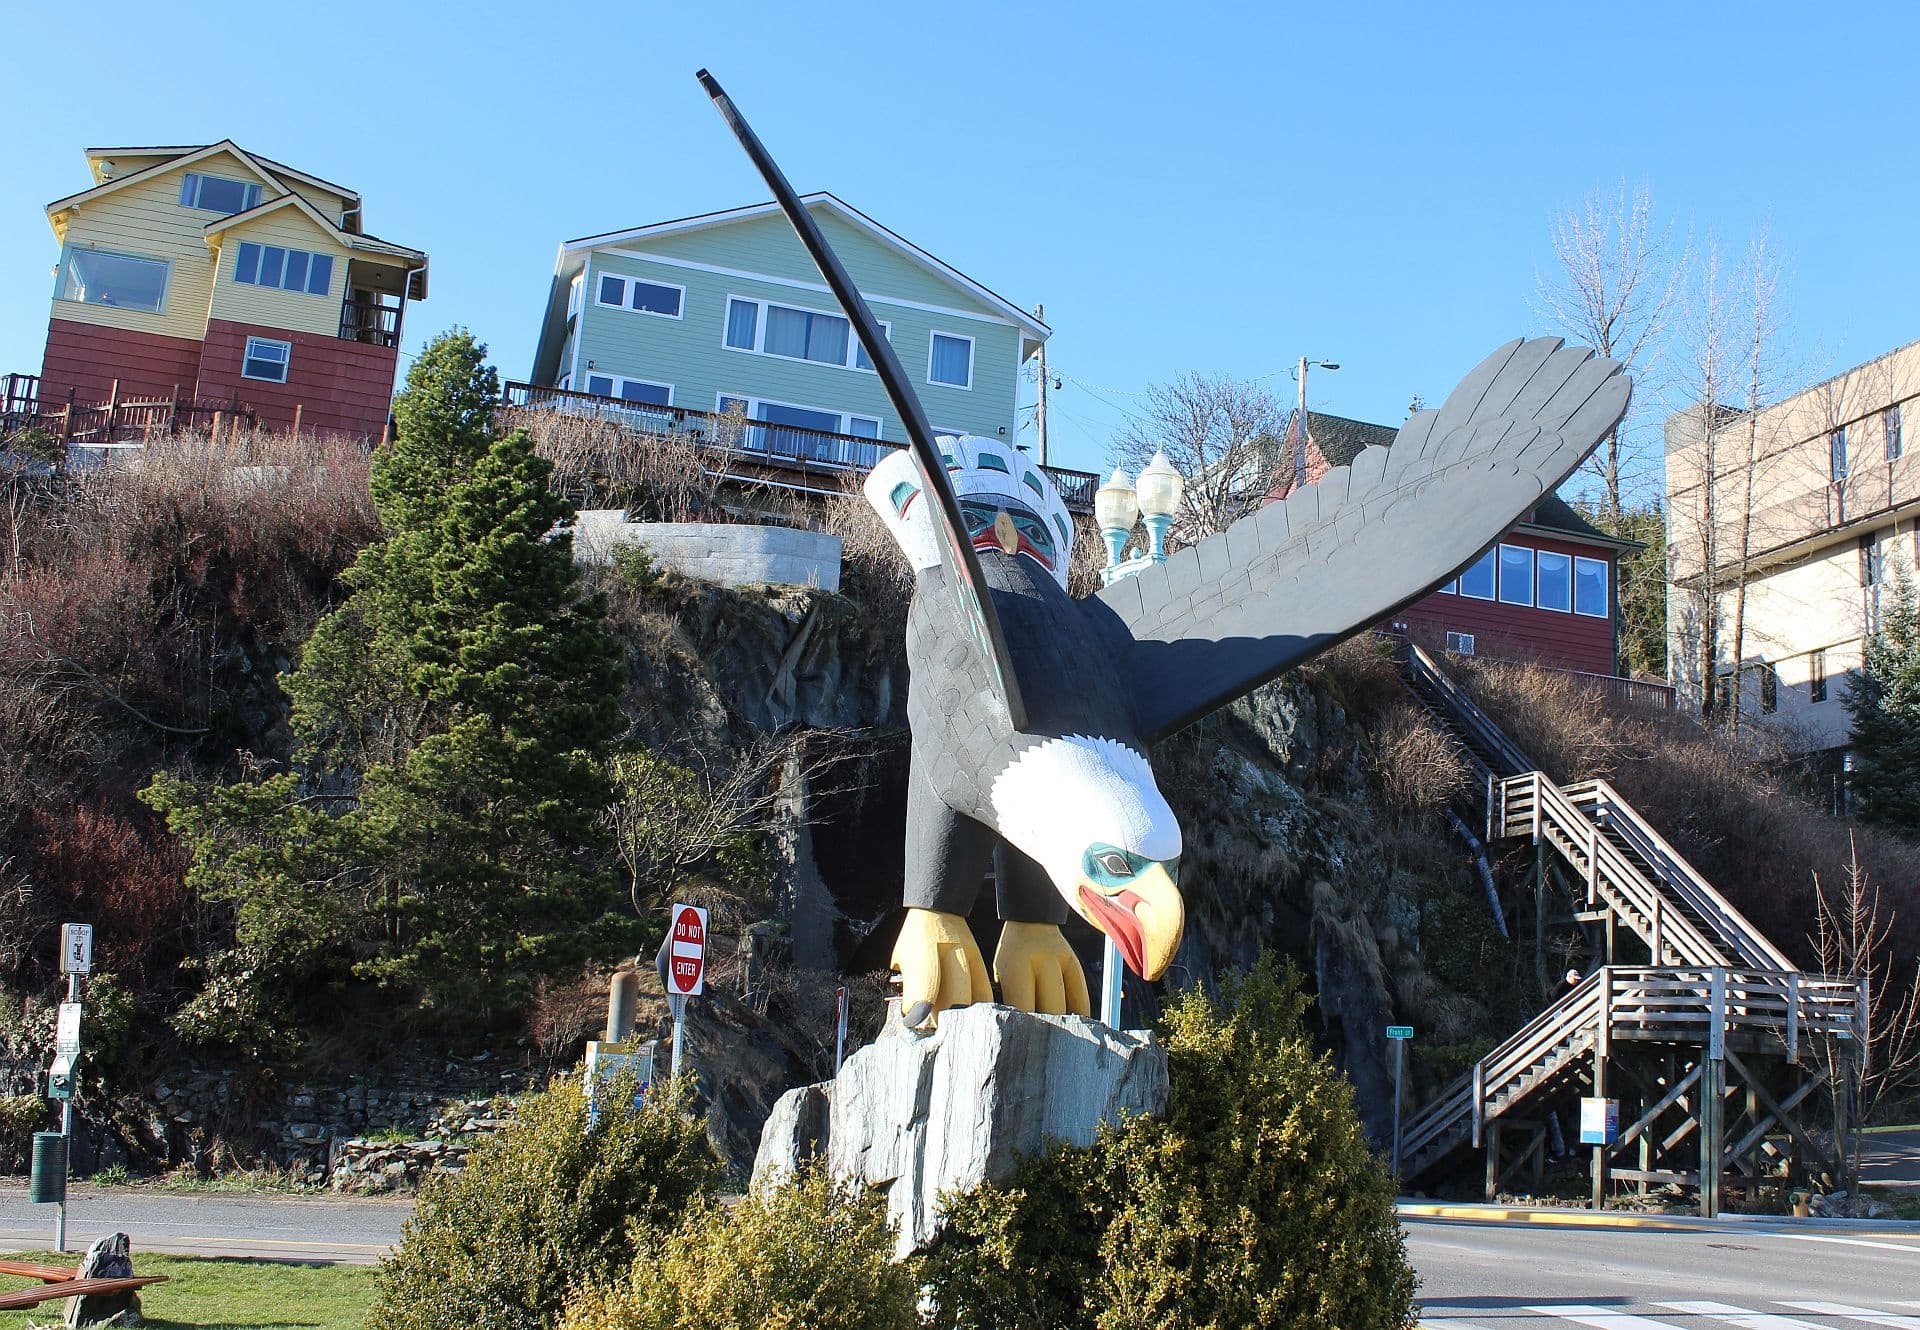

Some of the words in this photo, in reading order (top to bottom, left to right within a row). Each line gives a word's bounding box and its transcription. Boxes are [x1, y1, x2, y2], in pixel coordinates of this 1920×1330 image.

[677, 922, 686, 937] DO
[688, 925, 701, 939] NOT
[676, 961, 696, 977] ENTER
